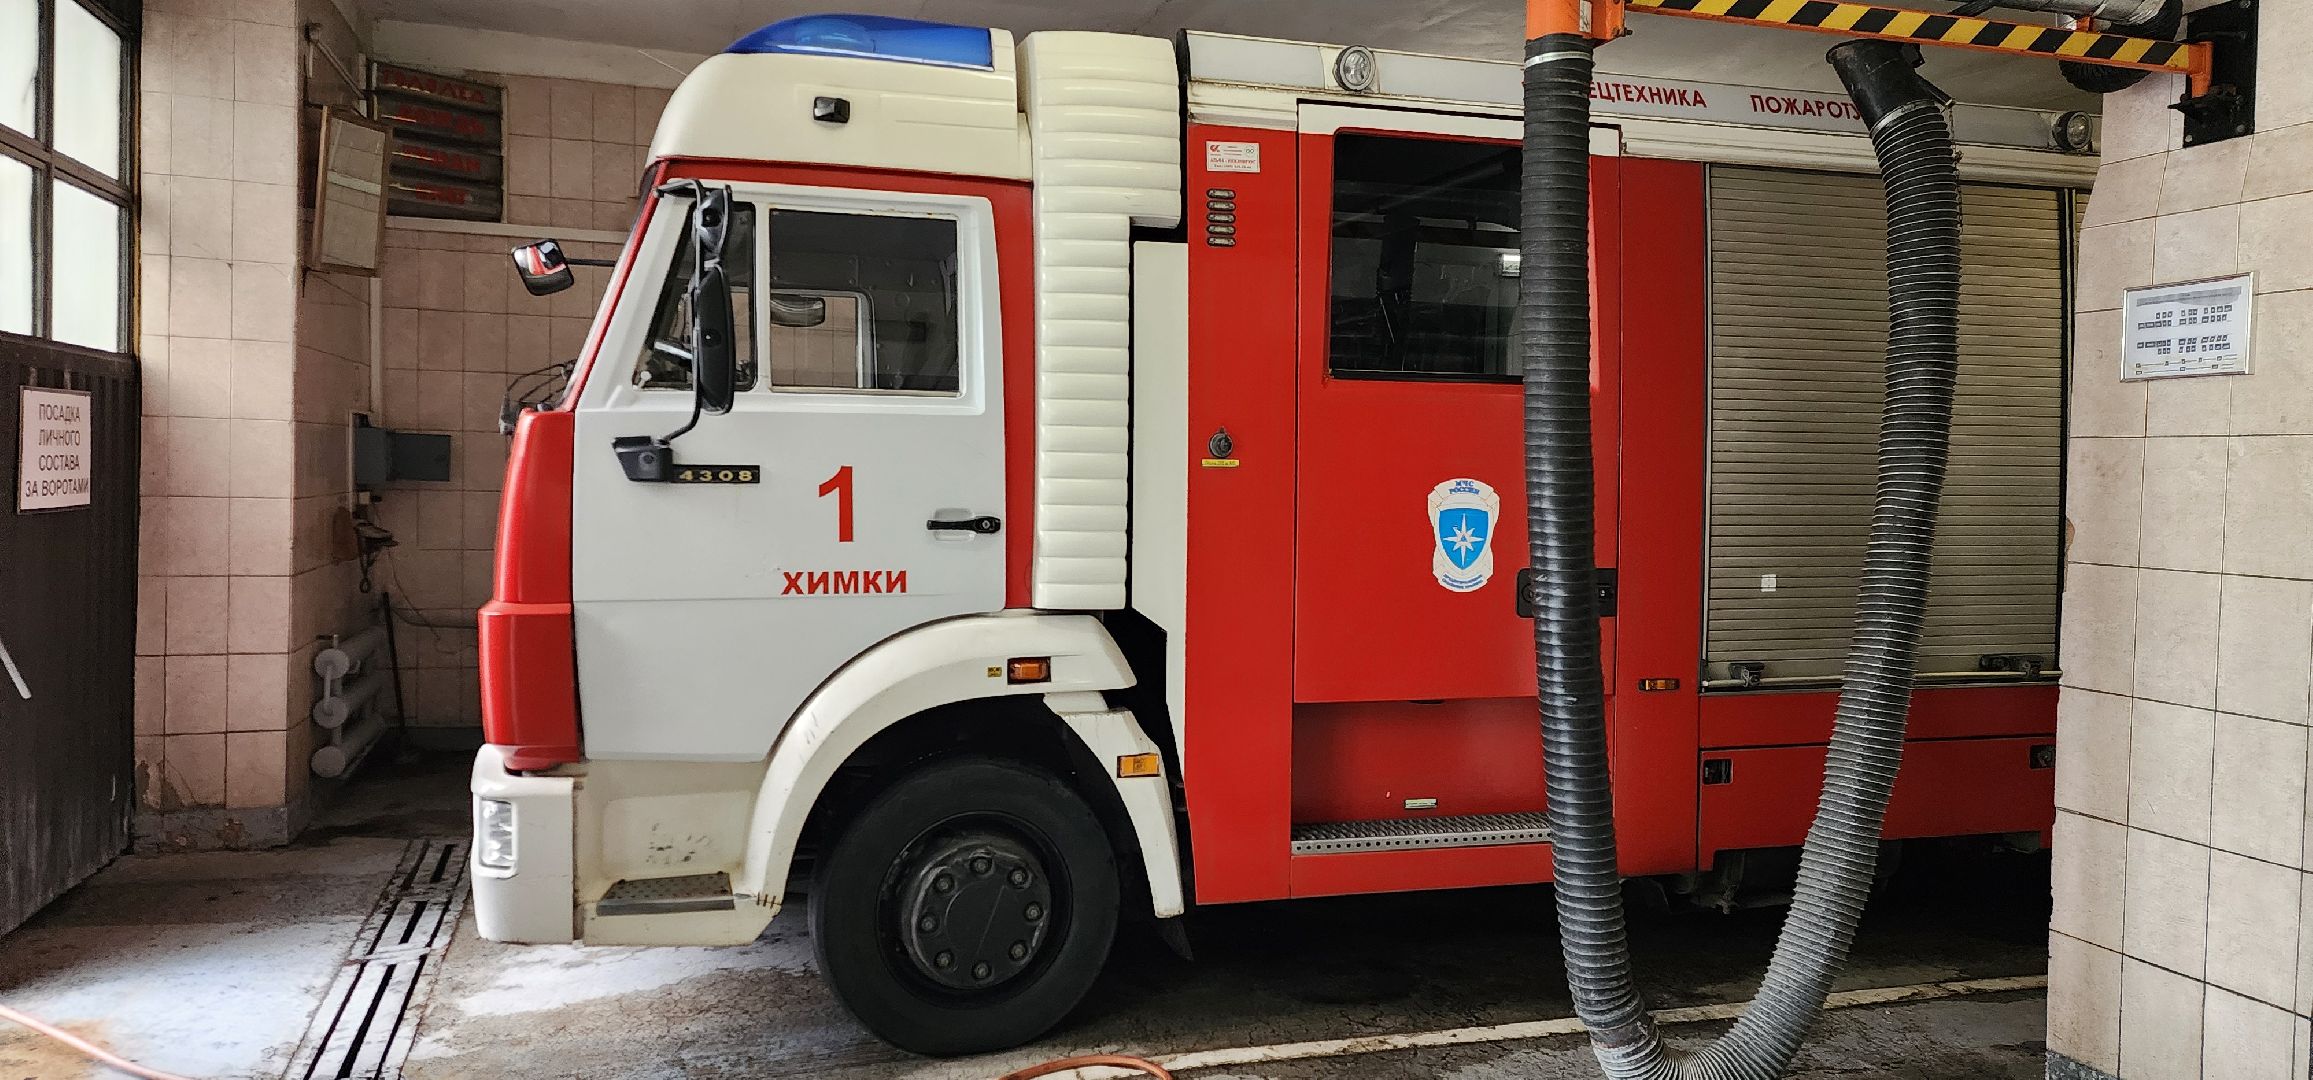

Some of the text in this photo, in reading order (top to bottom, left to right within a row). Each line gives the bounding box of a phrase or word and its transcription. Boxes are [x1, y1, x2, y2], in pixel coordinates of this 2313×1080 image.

[39, 403, 80, 423] ПОСАДКА
[38, 429, 80, 446] ЛИЧНОГО
[38, 454, 80, 471] СОСТАВА
[679, 469, 753, 482] 4308
[25, 478, 89, 497] ЗА ВОРОТАМИ
[818, 465, 854, 542] 1
[781, 570, 907, 595] ХИМКИ
